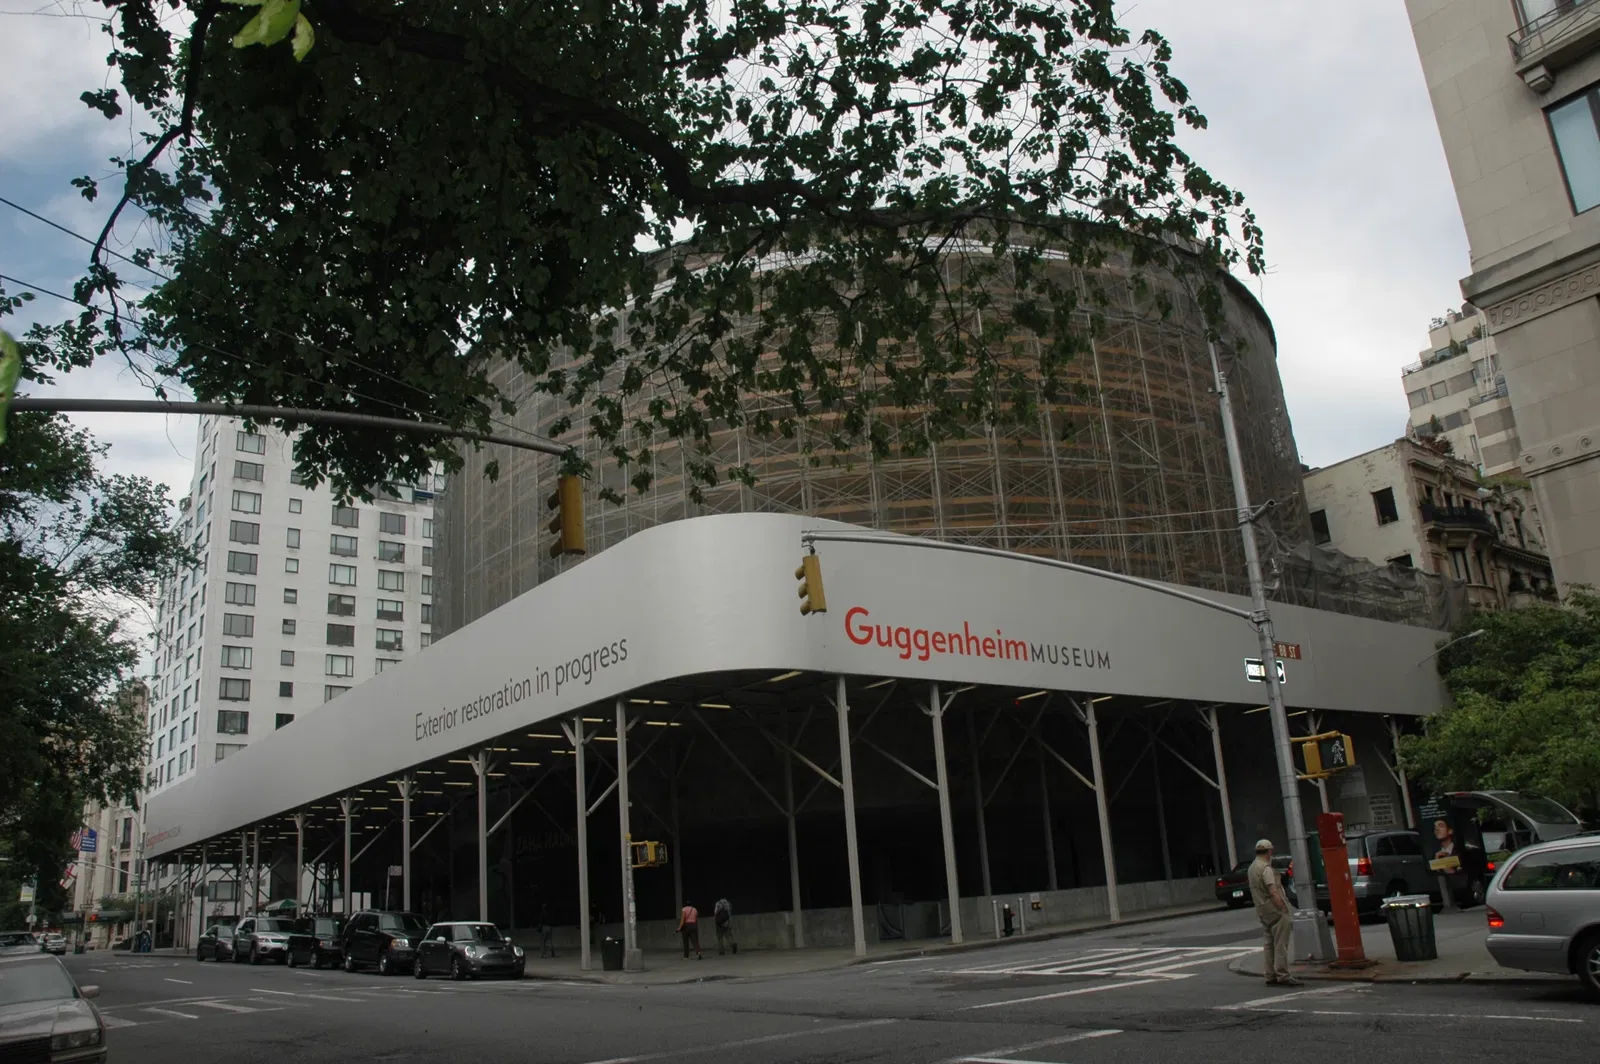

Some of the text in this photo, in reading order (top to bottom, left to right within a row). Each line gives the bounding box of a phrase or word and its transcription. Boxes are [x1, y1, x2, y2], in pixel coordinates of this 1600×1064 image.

[845, 606, 1111, 670] Guggenheim MUSEUM
[1289, 645, 1296, 659] ST
[415, 638, 628, 742] Exterior restoration in progress
